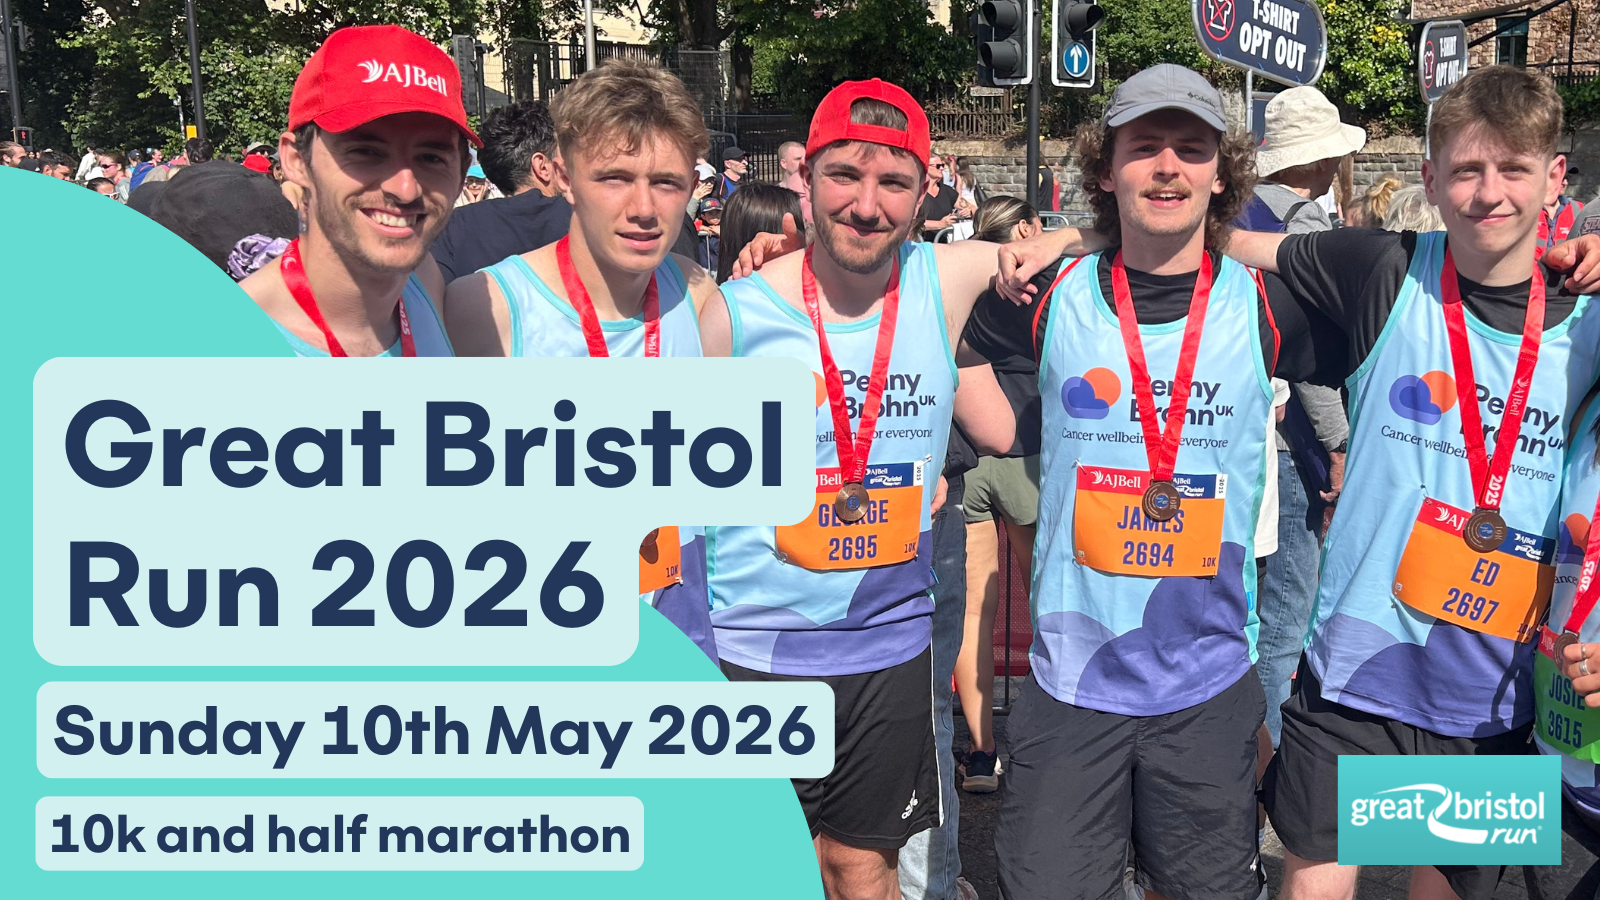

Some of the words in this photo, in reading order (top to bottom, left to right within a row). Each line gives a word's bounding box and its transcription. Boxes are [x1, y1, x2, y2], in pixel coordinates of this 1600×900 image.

[1253, 0, 1300, 35] T-SHIRT
[1239, 21, 1272, 60] OPT
[1274, 35, 1307, 73] OUT
[382, 62, 448, 97] AJBell
[1435, 61, 1448, 88] OPT
[1447, 59, 1460, 85] OUT
[648, 333, 659, 357] JBell
[839, 369, 922, 397] Peny
[1132, 374, 1222, 406] eny
[1474, 382, 1561, 436] Peny
[1061, 427, 1094, 441] Cancer
[1096, 431, 1144, 444] wellbei
[1381, 424, 1423, 446] Cancer
[1424, 438, 1468, 460] wellbei
[1508, 463, 1556, 482] veryone
[1103, 473, 1141, 489] AJBell
[1484, 473, 1504, 506] 2025
[818, 499, 889, 528] GEGE
[828, 534, 878, 561] 2695
[904, 542, 917, 554] 10K
[1122, 540, 1174, 567] 2694
[1202, 557, 1216, 567] 10K
[666, 564, 679, 578] 10K
[1470, 557, 1501, 587] ED
[1554, 574, 1579, 586] ance
[1579, 560, 1595, 592] 2025
[1441, 587, 1500, 624] 2697
[1548, 709, 1583, 749] 3615
